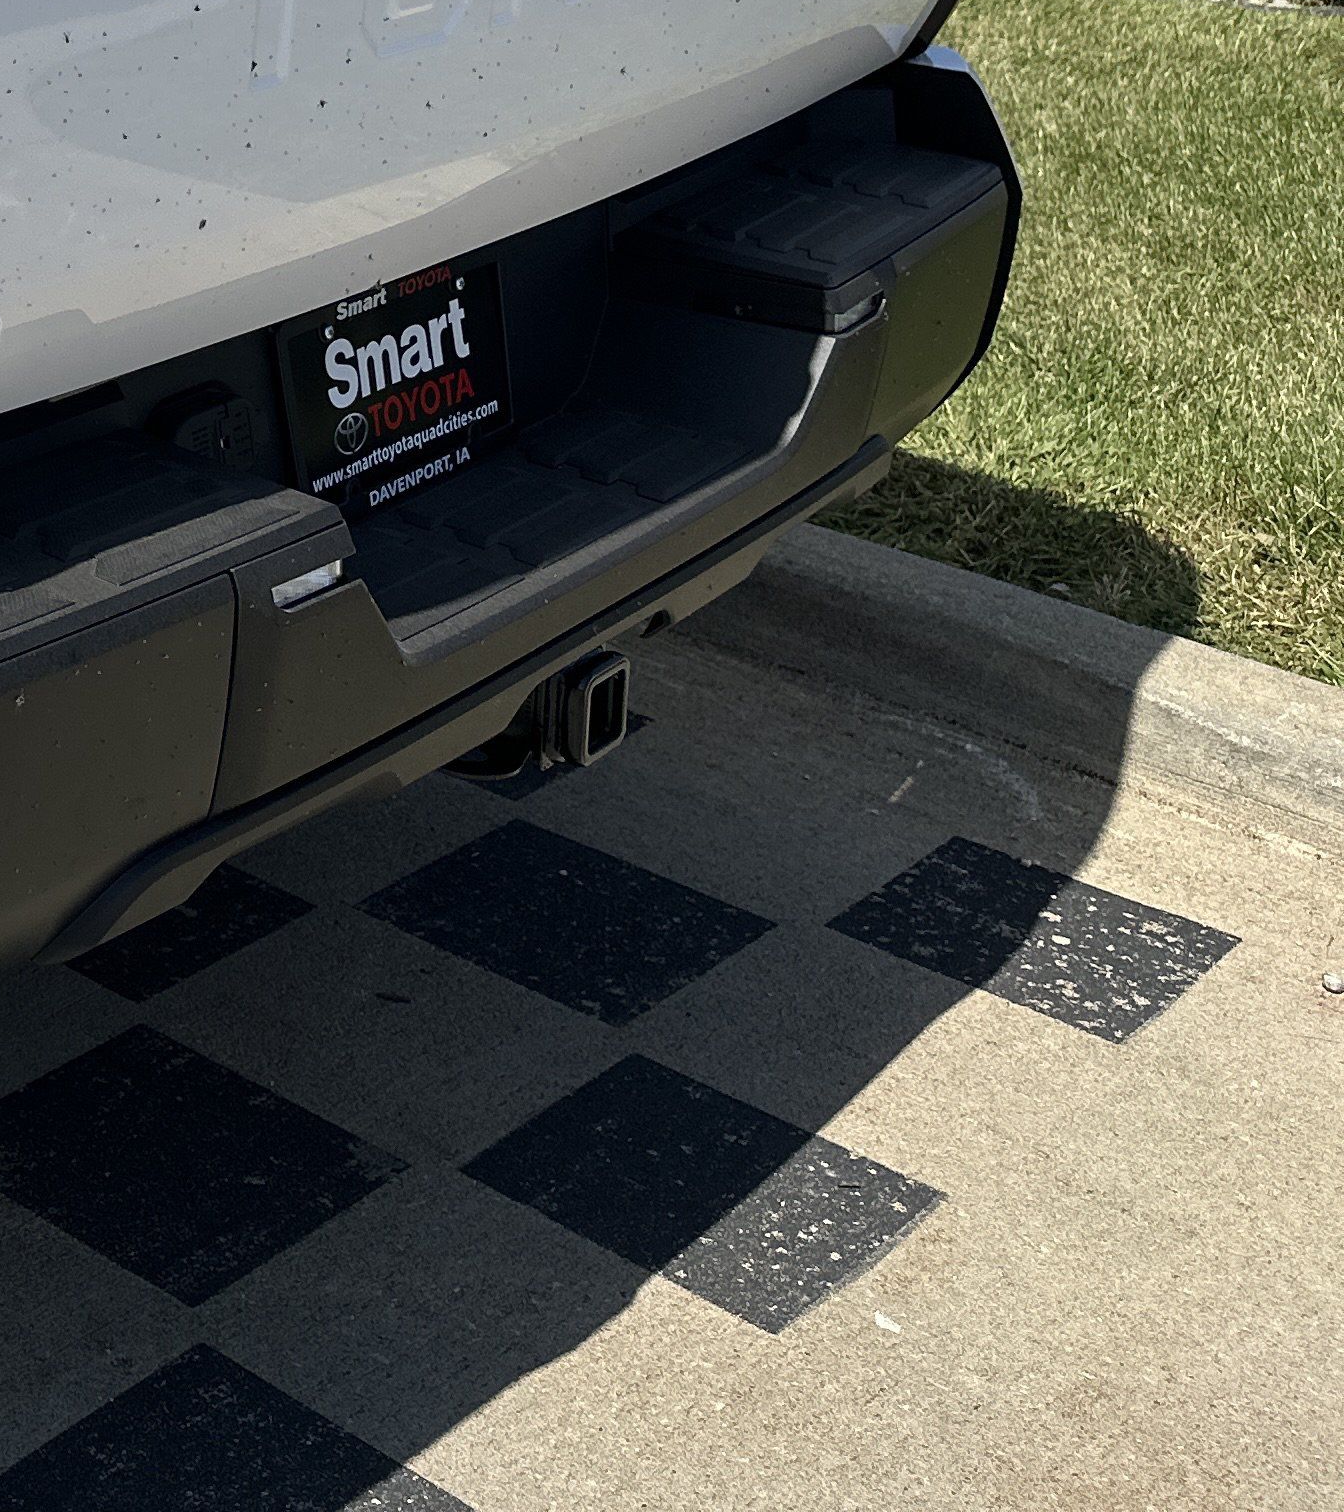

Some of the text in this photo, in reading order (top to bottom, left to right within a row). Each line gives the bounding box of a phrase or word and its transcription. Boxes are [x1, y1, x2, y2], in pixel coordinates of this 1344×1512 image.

[336, 265, 452, 321] Smart TOYOTA
[324, 298, 470, 409] Smart
[368, 368, 476, 437] TOYOTA
[312, 399, 499, 493] www.smarttoyotaquadcities.com
[369, 446, 471, 507] DAVENPORT, IA
